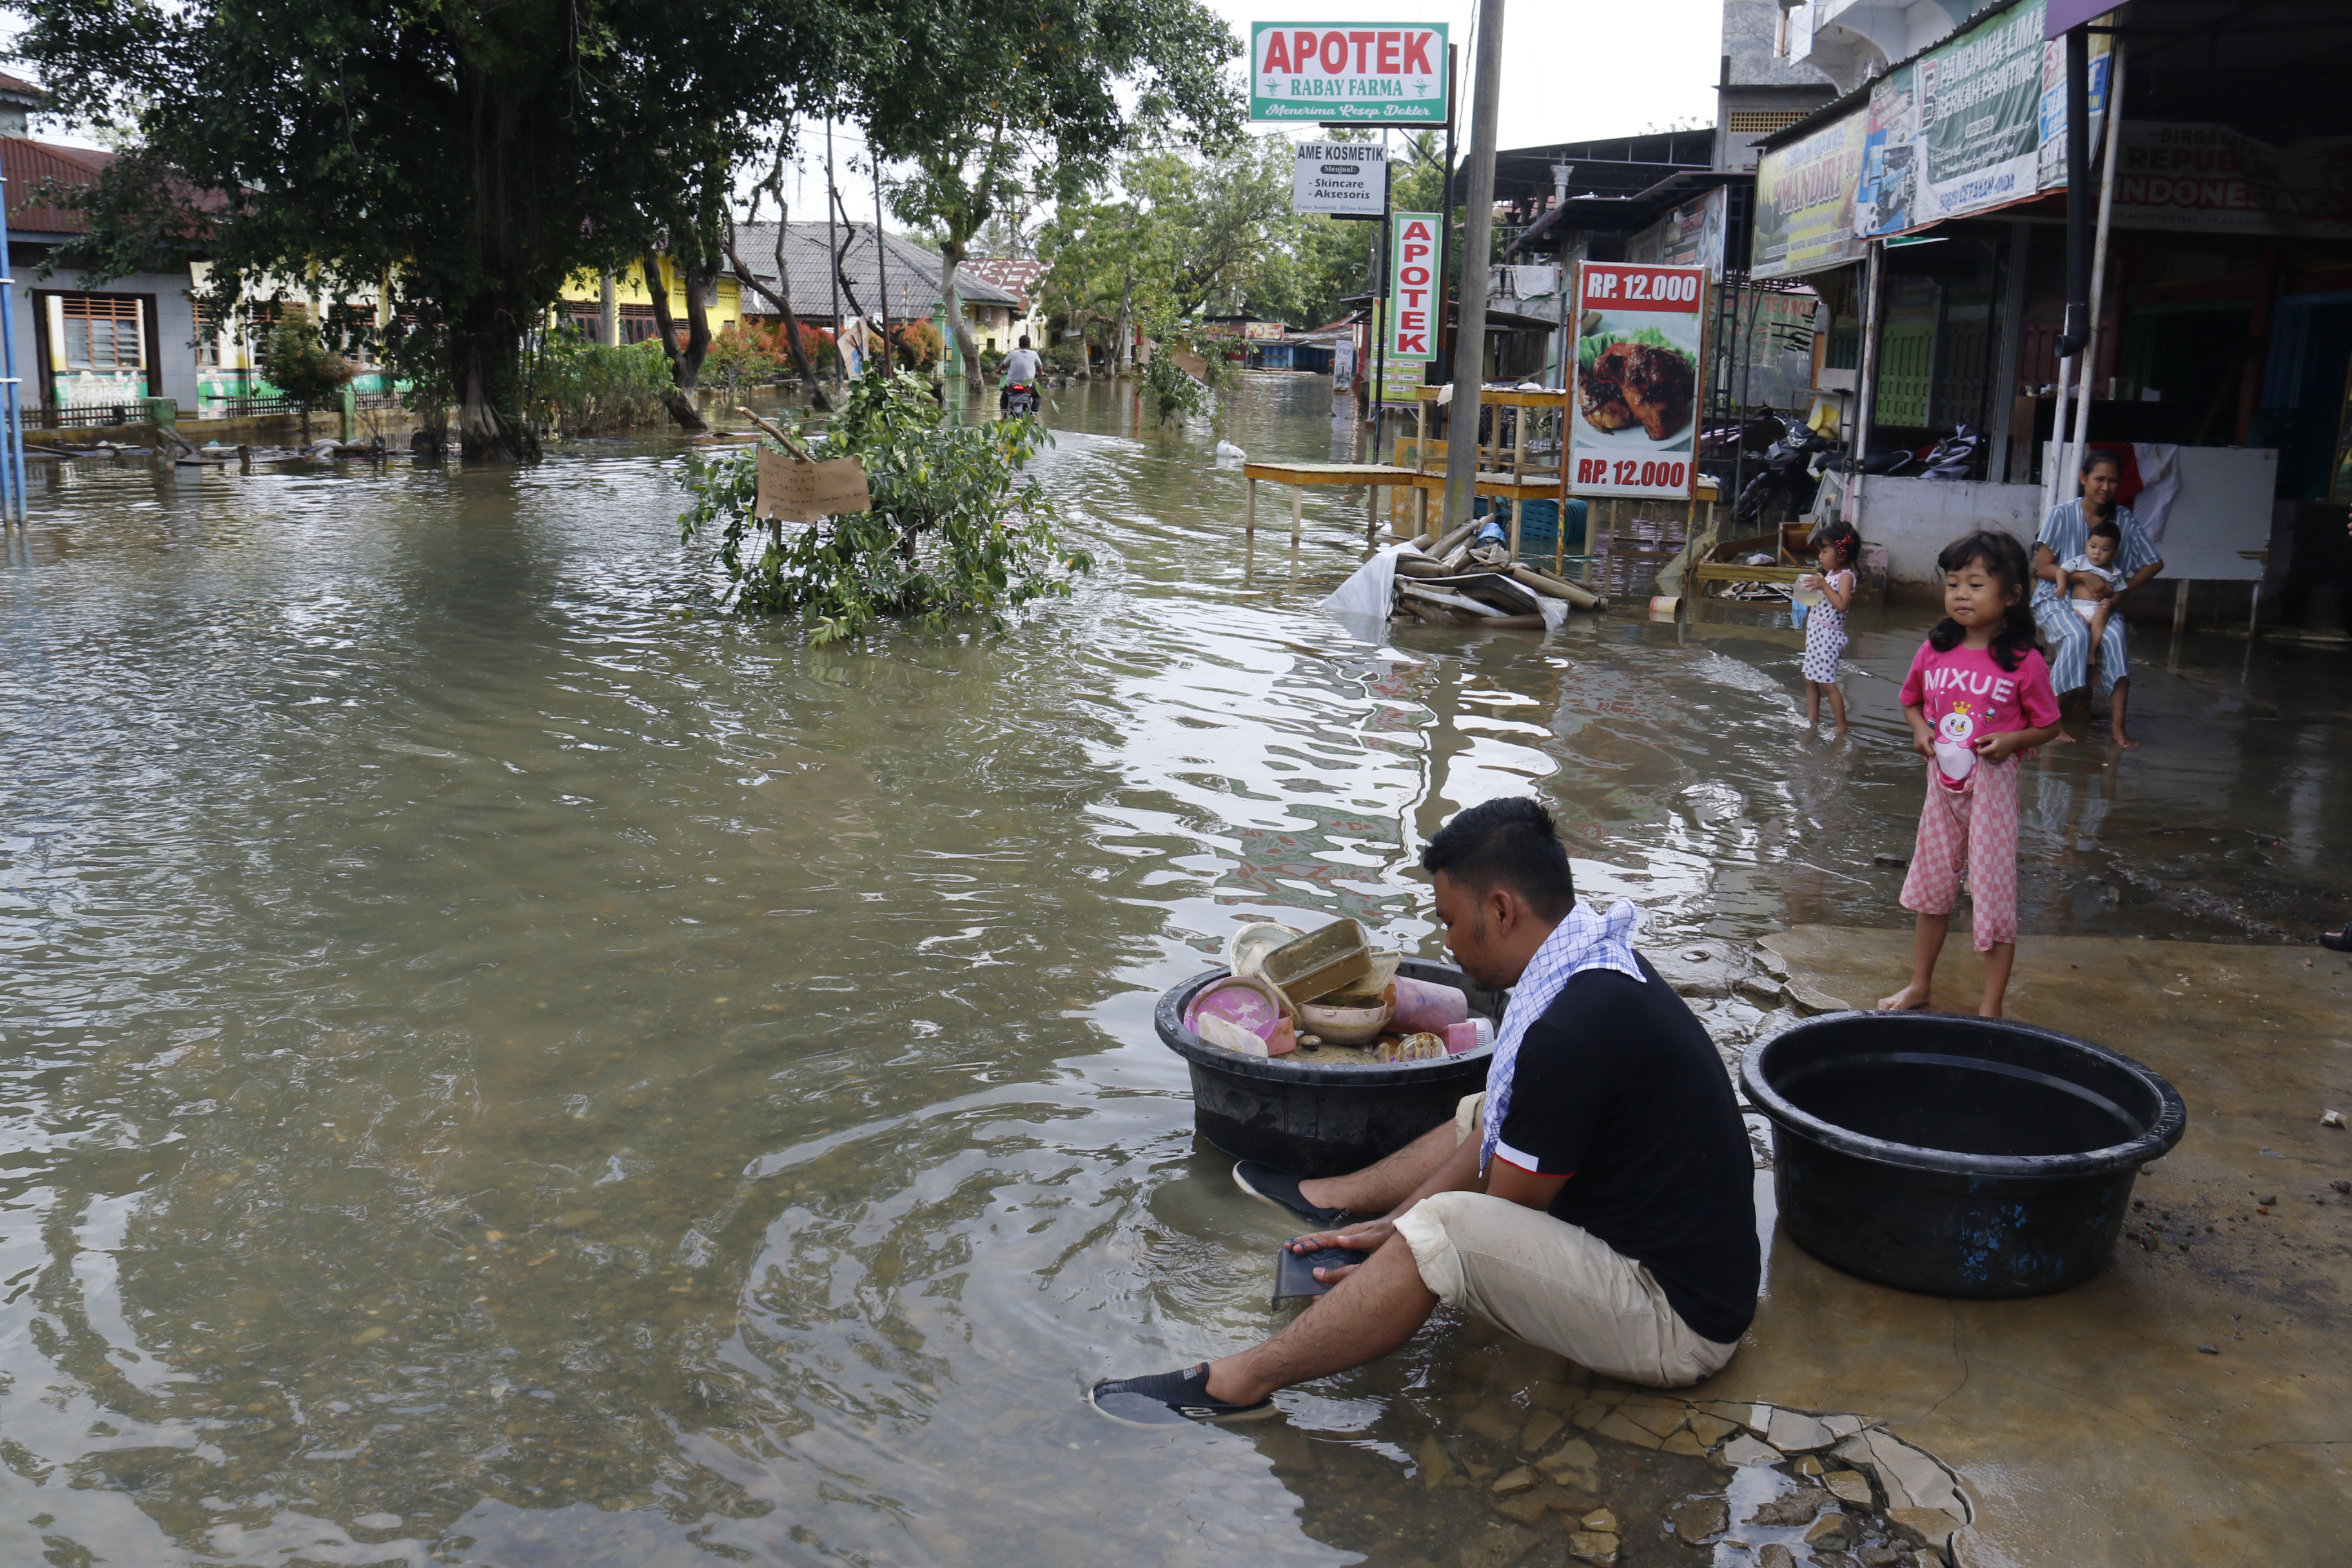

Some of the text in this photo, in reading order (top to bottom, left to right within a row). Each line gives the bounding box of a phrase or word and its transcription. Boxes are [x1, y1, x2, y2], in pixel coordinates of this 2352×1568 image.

[1262, 31, 1434, 75] APOTEK
[1940, 28, 2003, 90] PANDAWA
[2006, 6, 2043, 57] LIMA
[1290, 79, 1404, 97] RABAY FARMA
[1936, 77, 1982, 121] BERKAH
[1982, 50, 2037, 101] PRINTING
[1265, 103, 1431, 119] Menerima Resep Dokter
[1298, 145, 1384, 161] AME KOSMETIK
[2126, 146, 2283, 182] REPUBLIK
[1315, 179, 1364, 188] Skincare
[1324, 166, 1357, 174] Menjual:
[1314, 190, 1370, 199] Aksesoris
[2113, 174, 2300, 215] INDONESIA
[2128, 212, 2174, 222] AGUSTUS
[1397, 221, 1432, 353] APOTEK
[1587, 273, 1697, 302] RP. 12.000
[1578, 458, 1685, 487] RP. 12.000
[1925, 667, 2015, 703] MIXUE
